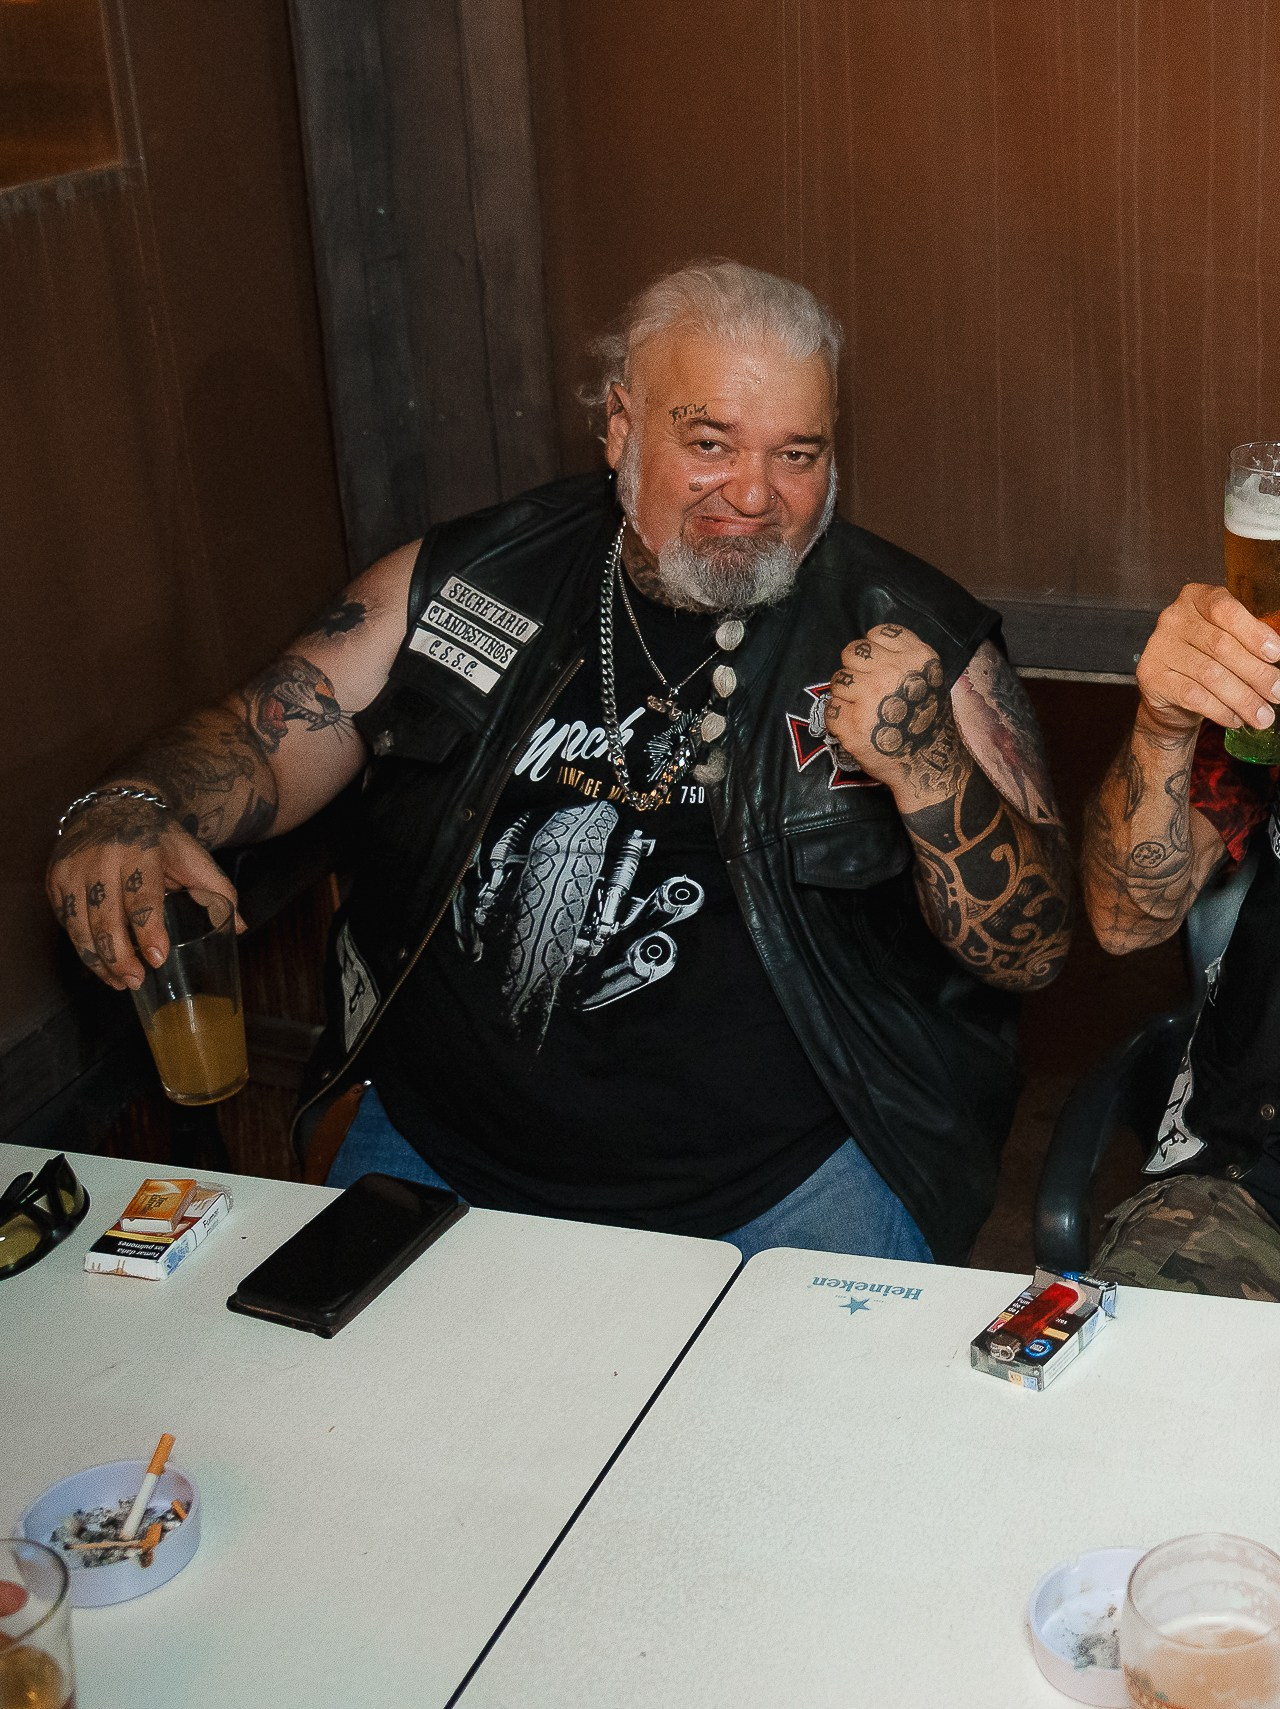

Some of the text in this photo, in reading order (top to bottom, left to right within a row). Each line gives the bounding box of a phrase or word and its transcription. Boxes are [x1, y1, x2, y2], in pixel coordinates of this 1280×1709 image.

[448, 582, 530, 637] SECRETARIO
[427, 605, 514, 664] CLANDESTINOS
[680, 785, 705, 805] 750
[117, 1241, 155, 1250] pulmones
[136, 1250, 160, 1258] Fumar
[812, 1276, 924, 1301] Heineken
